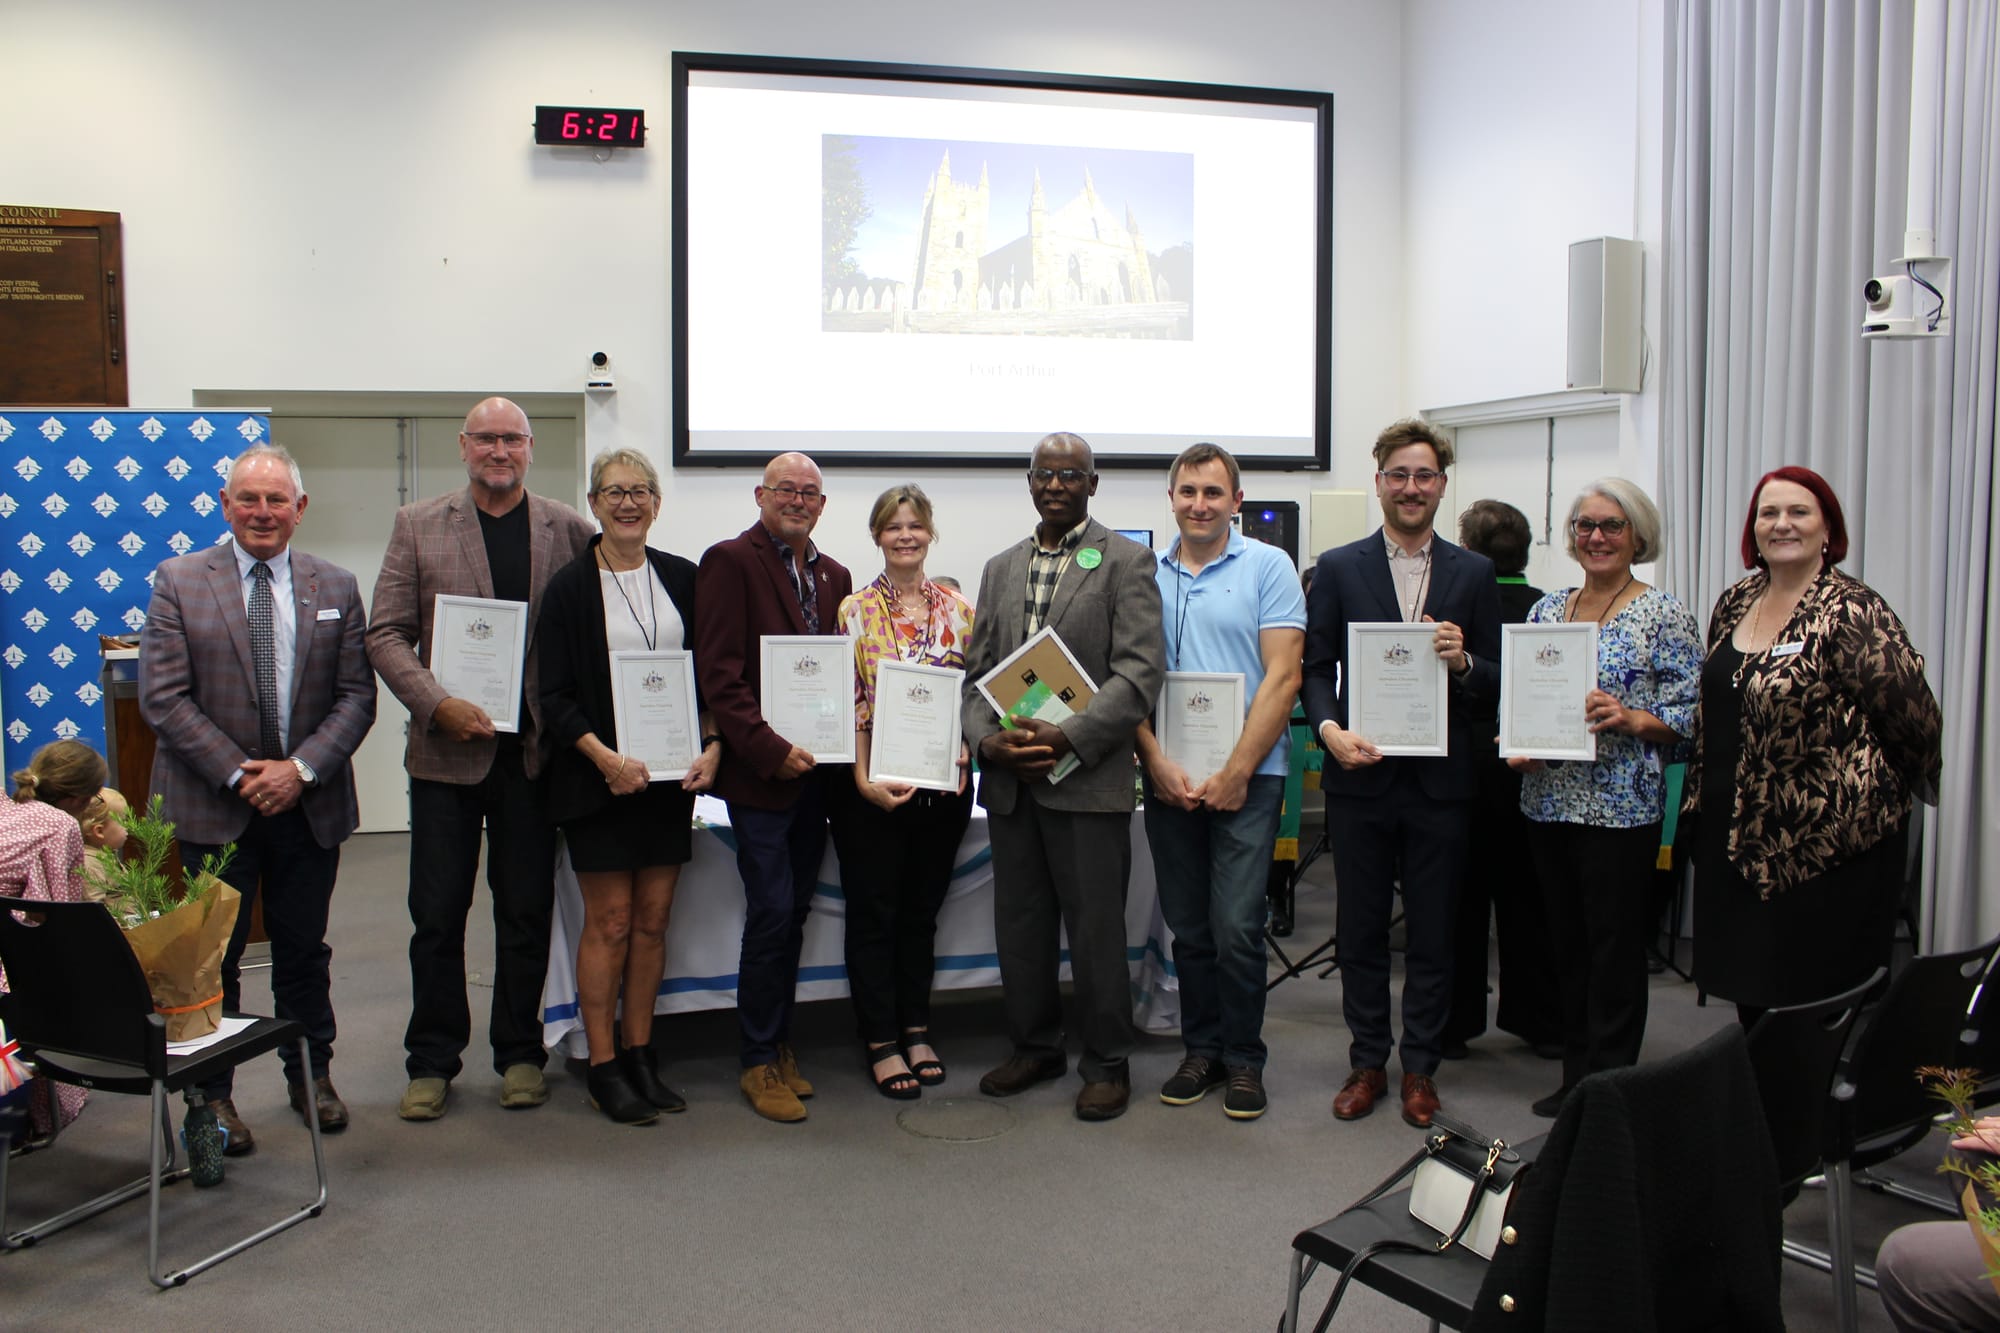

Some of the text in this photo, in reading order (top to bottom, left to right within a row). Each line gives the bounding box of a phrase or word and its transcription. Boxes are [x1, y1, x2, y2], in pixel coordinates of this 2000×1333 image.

[562, 112, 639, 140] 6:21
[0, 207, 61, 218] COUNCIL
[969, 360, 1056, 377] Port Arthur
